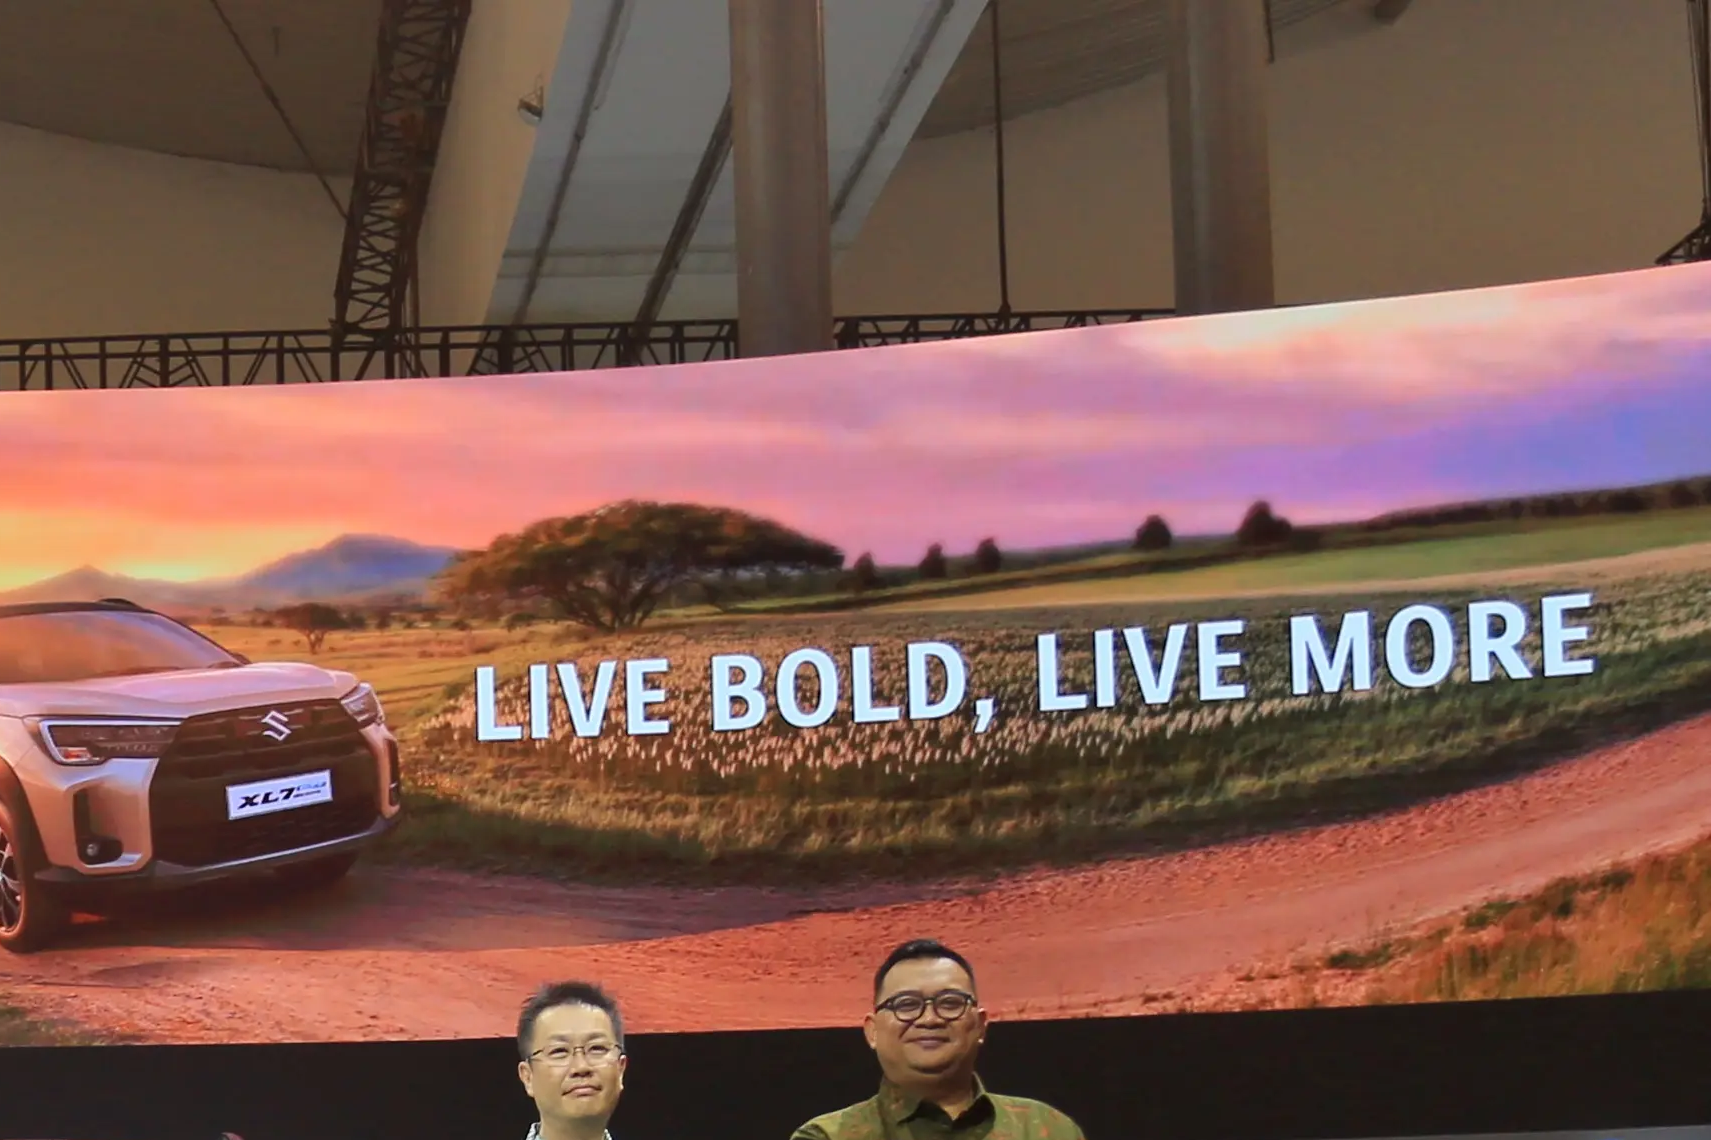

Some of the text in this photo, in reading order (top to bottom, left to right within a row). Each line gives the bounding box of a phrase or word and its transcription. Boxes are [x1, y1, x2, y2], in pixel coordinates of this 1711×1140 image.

[473, 592, 1595, 742] LIVE BOLD, LIVE MORE
[237, 787, 295, 810] XL7
